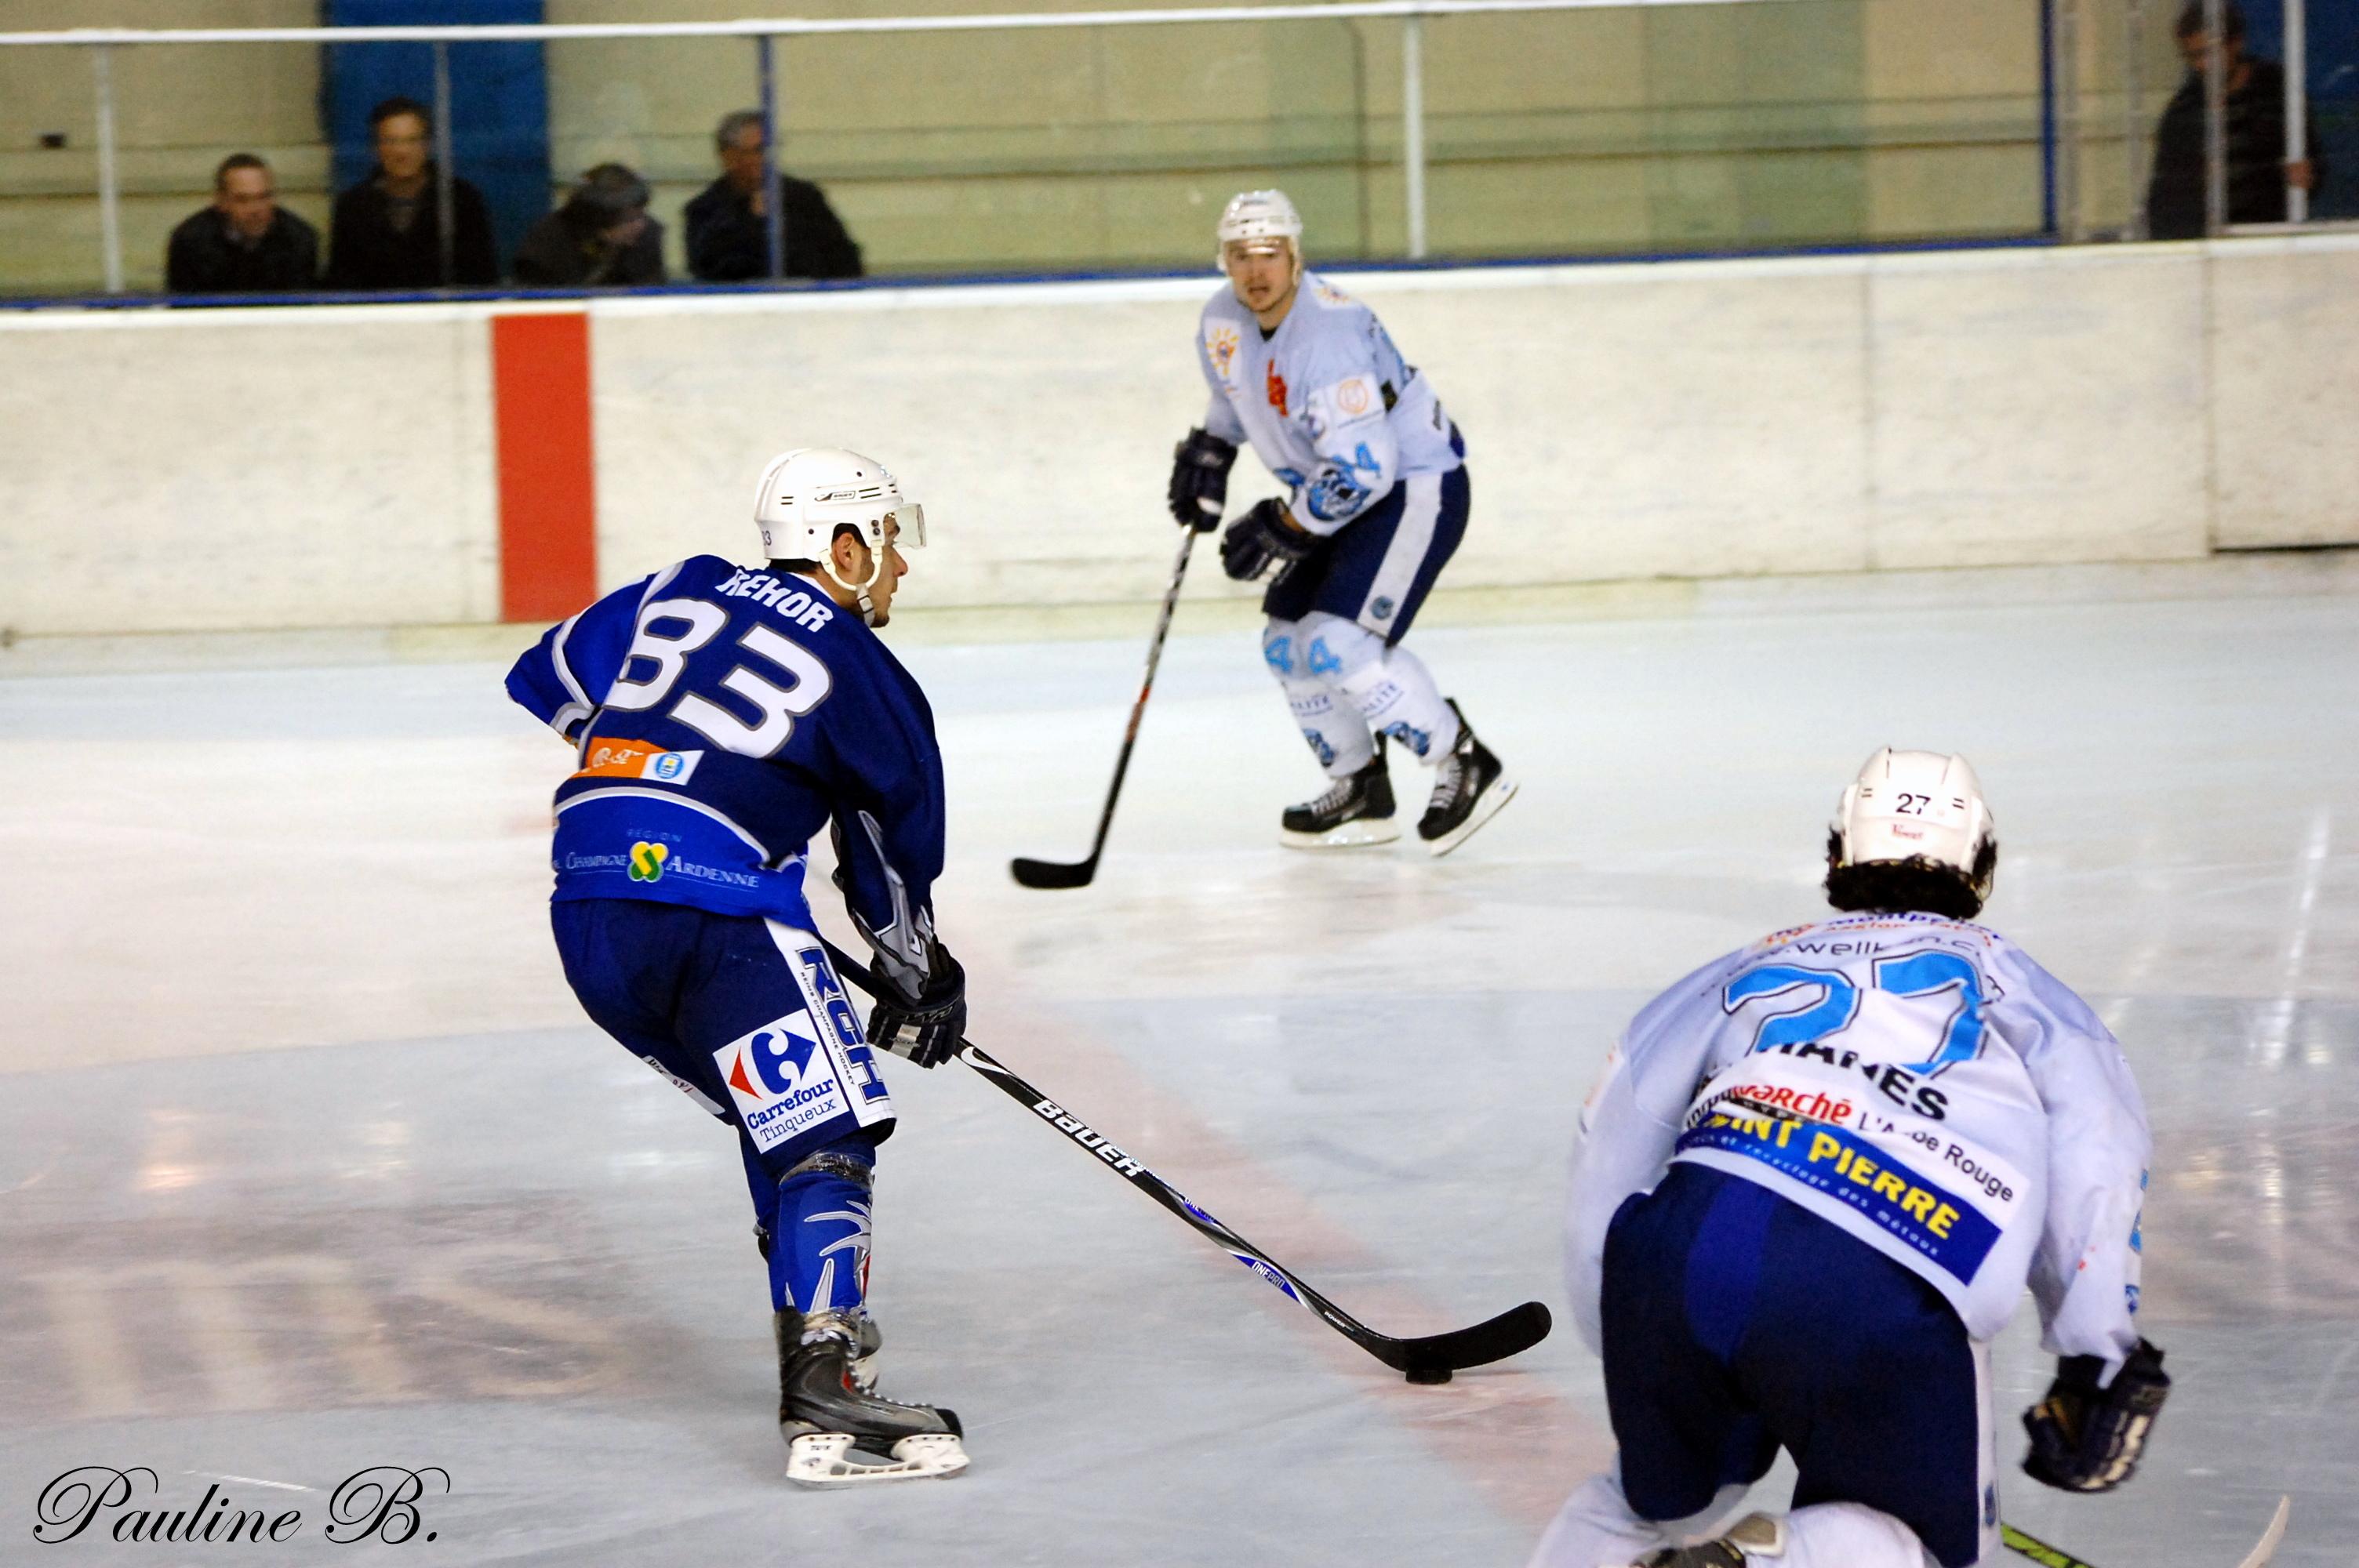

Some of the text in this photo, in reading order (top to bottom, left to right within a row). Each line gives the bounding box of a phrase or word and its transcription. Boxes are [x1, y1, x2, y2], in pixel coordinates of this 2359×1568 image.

[714, 568, 834, 633] REHOR
[601, 597, 834, 759] 83
[1896, 793, 1931, 815] 27
[666, 855, 760, 887] ARDENNE
[796, 946, 891, 1105] RCH
[813, 1000, 838, 1050] CHAMPAGNE
[838, 1052, 856, 1086] HOCKEY
[747, 1079, 834, 1129] Carrefour
[760, 1098, 837, 1143] Tinqueux
[1033, 1099, 1145, 1177] BAUER
[1808, 1131, 1960, 1240] PIERRE
[1945, 1143, 2014, 1203] Rouge
